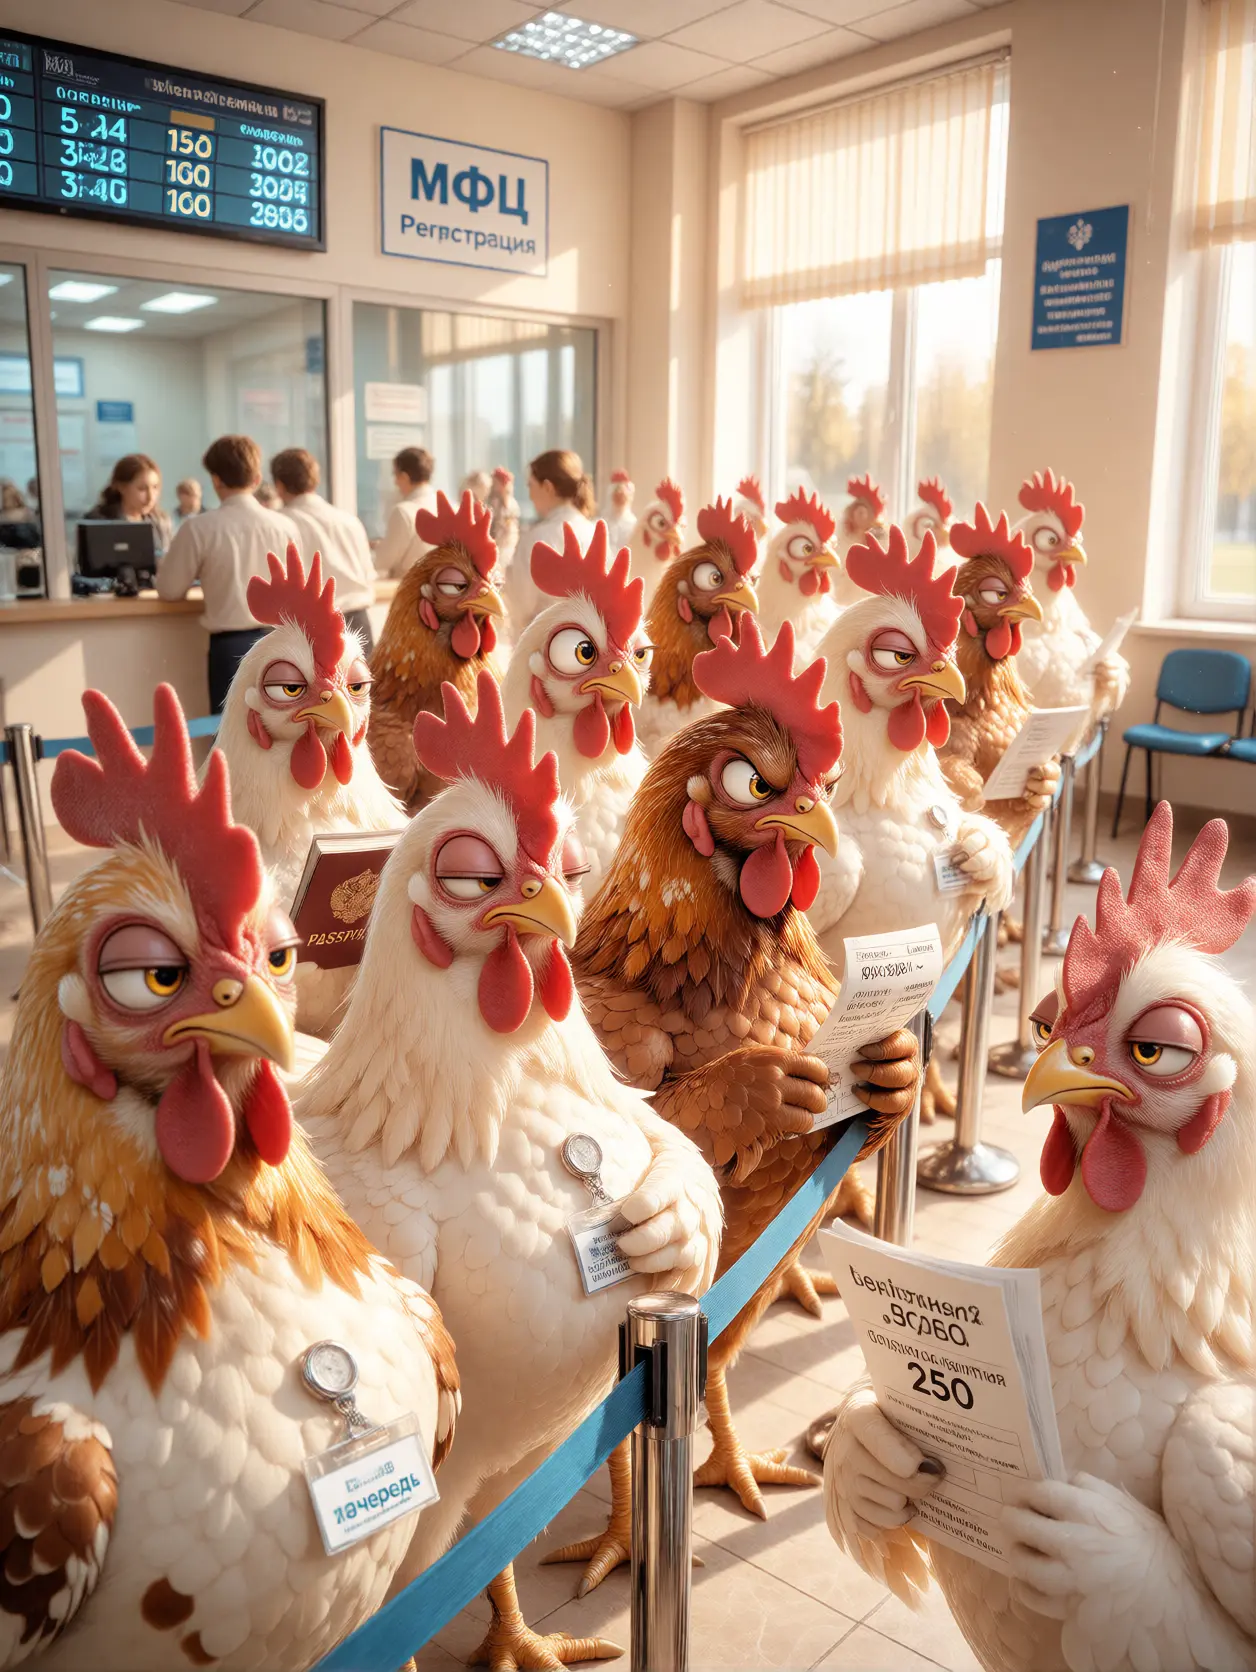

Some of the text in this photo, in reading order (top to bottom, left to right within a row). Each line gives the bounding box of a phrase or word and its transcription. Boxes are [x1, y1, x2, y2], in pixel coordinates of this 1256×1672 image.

[168, 129, 212, 158] 150
[410, 157, 528, 226] МФЦ
[907, 1361, 975, 1411] 250
